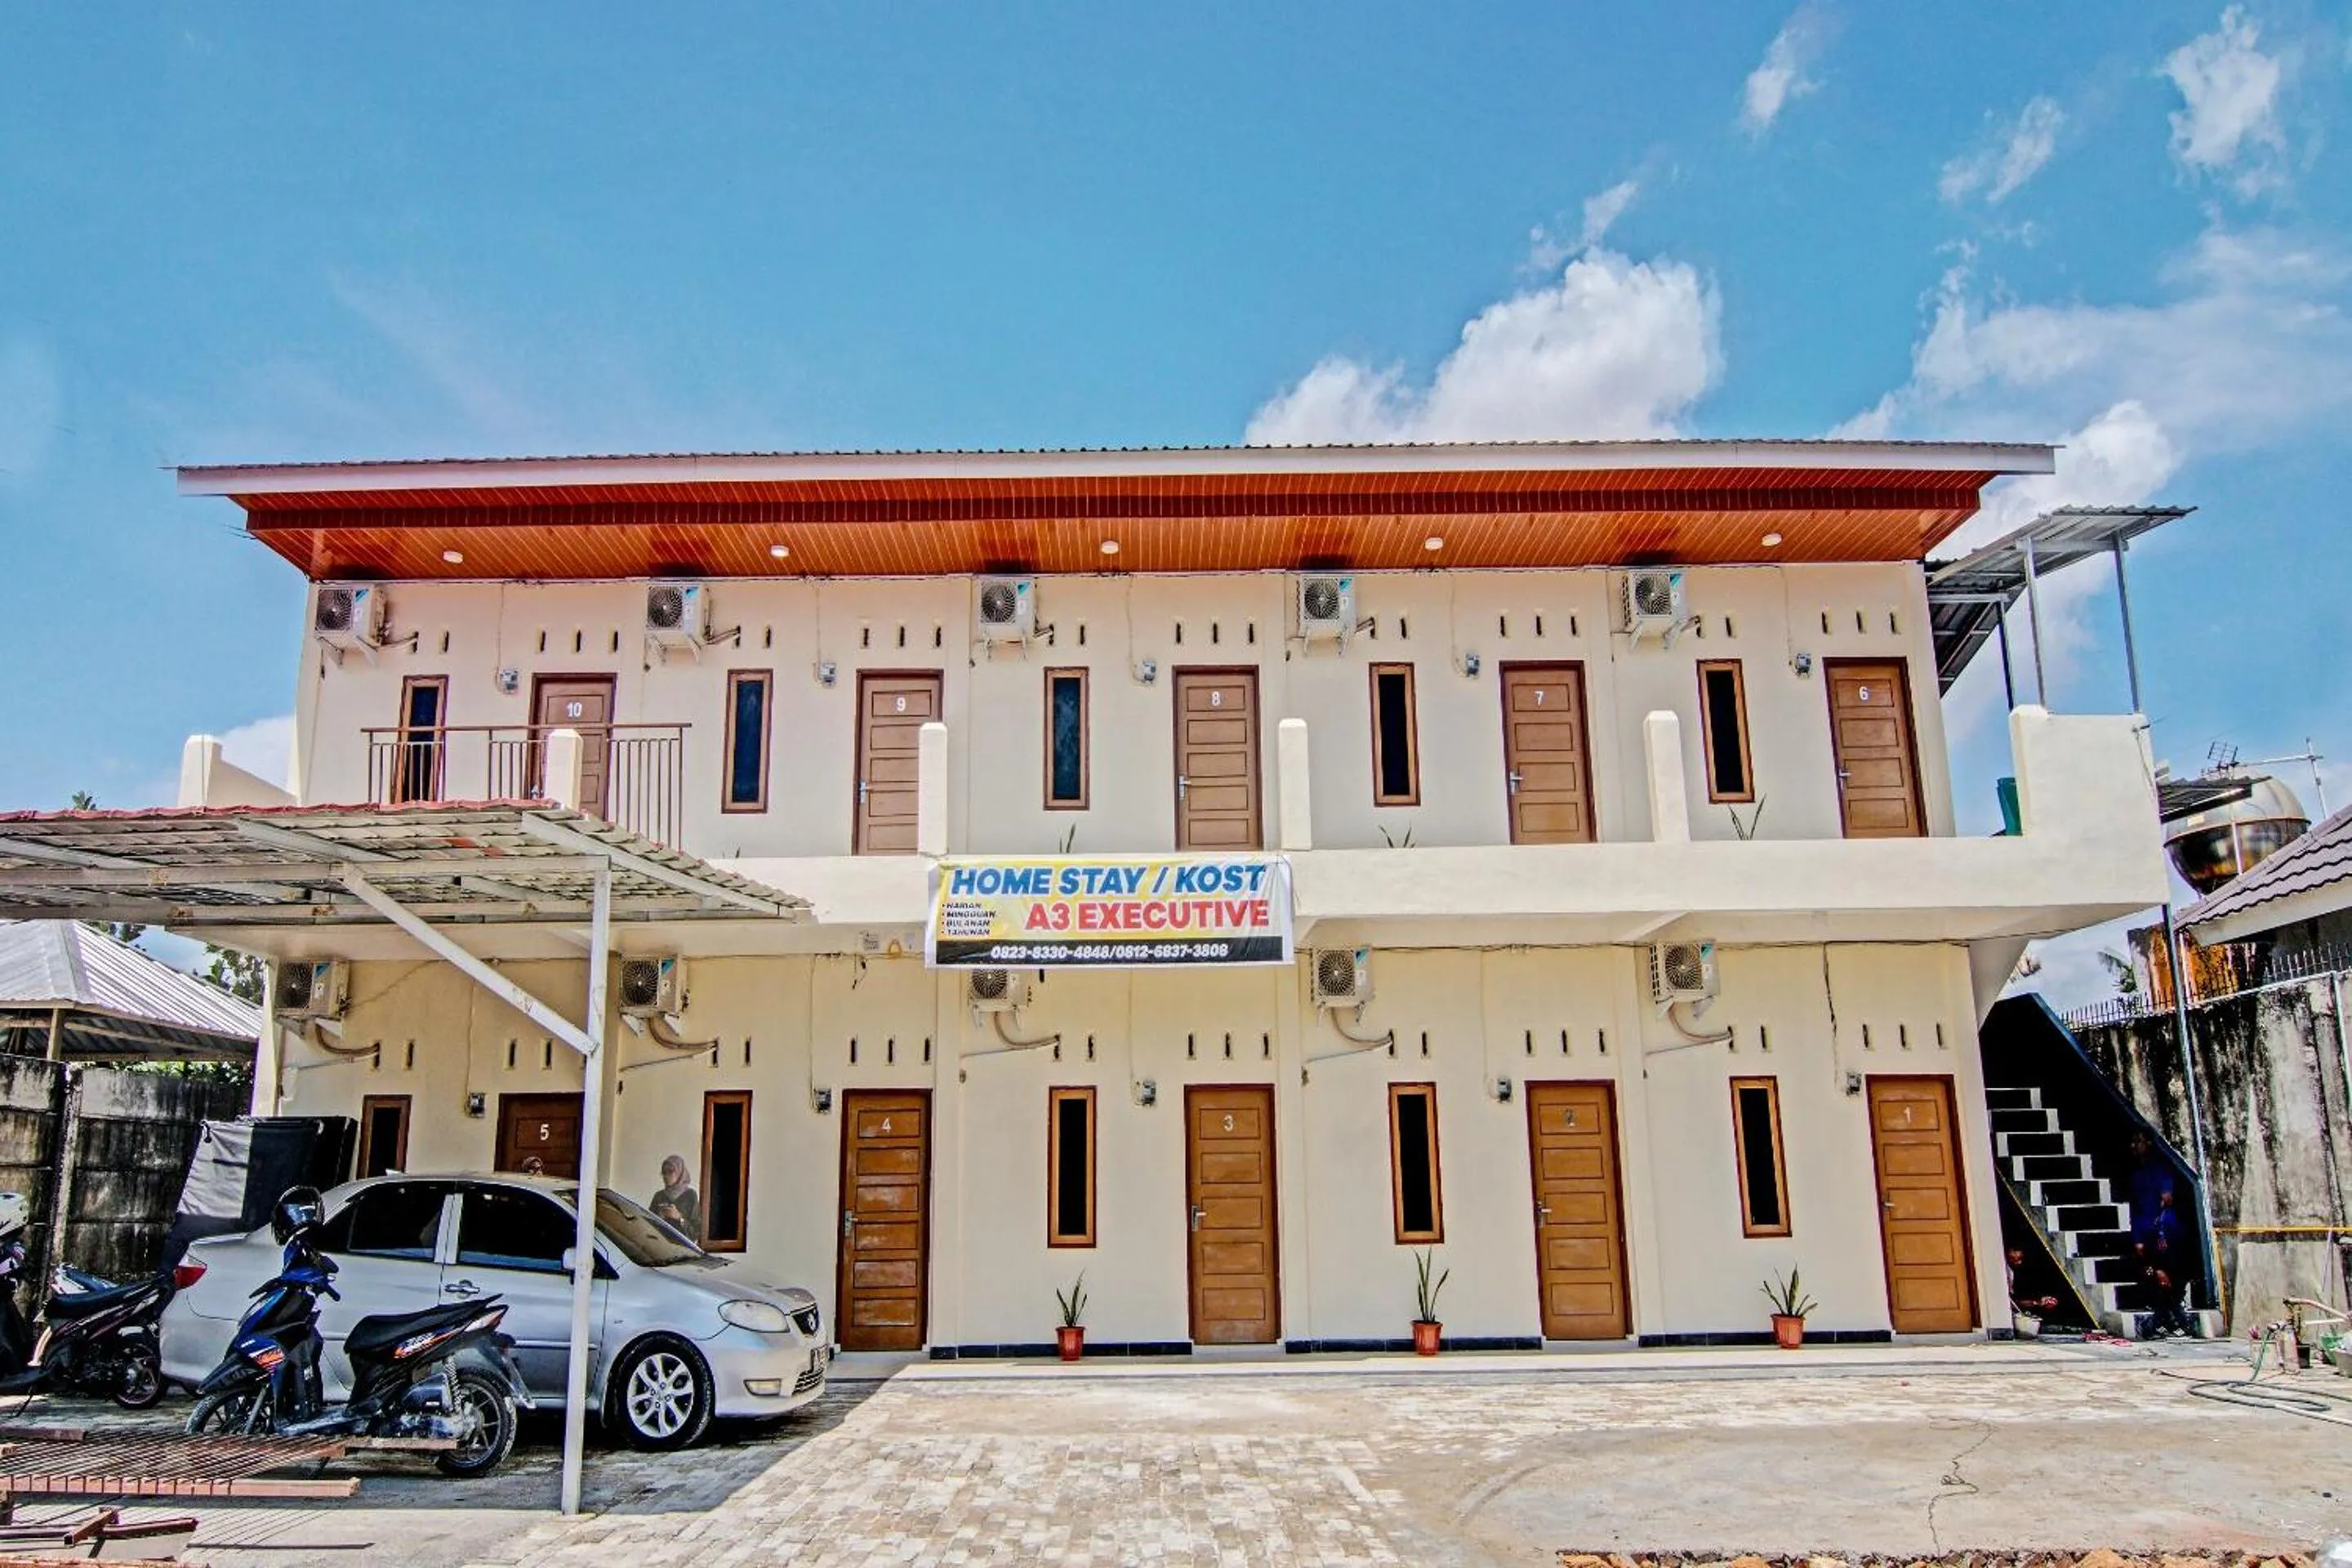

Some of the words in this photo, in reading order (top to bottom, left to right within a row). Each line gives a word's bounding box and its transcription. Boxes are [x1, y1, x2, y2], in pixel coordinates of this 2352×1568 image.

[1211, 691, 1221, 706] 8
[1535, 690, 1544, 706] 7
[1859, 686, 1869, 702] 6
[567, 701, 583, 718] 10
[896, 697, 906, 712] 9
[951, 867, 1053, 895] HOME
[1058, 867, 1146, 894] STAY
[1152, 866, 1169, 893] /
[1174, 865, 1265, 893] KOST
[1026, 902, 1070, 930] A3
[1078, 900, 1269, 929] EXECUTIVE
[1223, 1115, 1234, 1132] 3
[1903, 1107, 1912, 1125] 1
[539, 1124, 550, 1141] 5
[881, 1117, 892, 1134] 4
